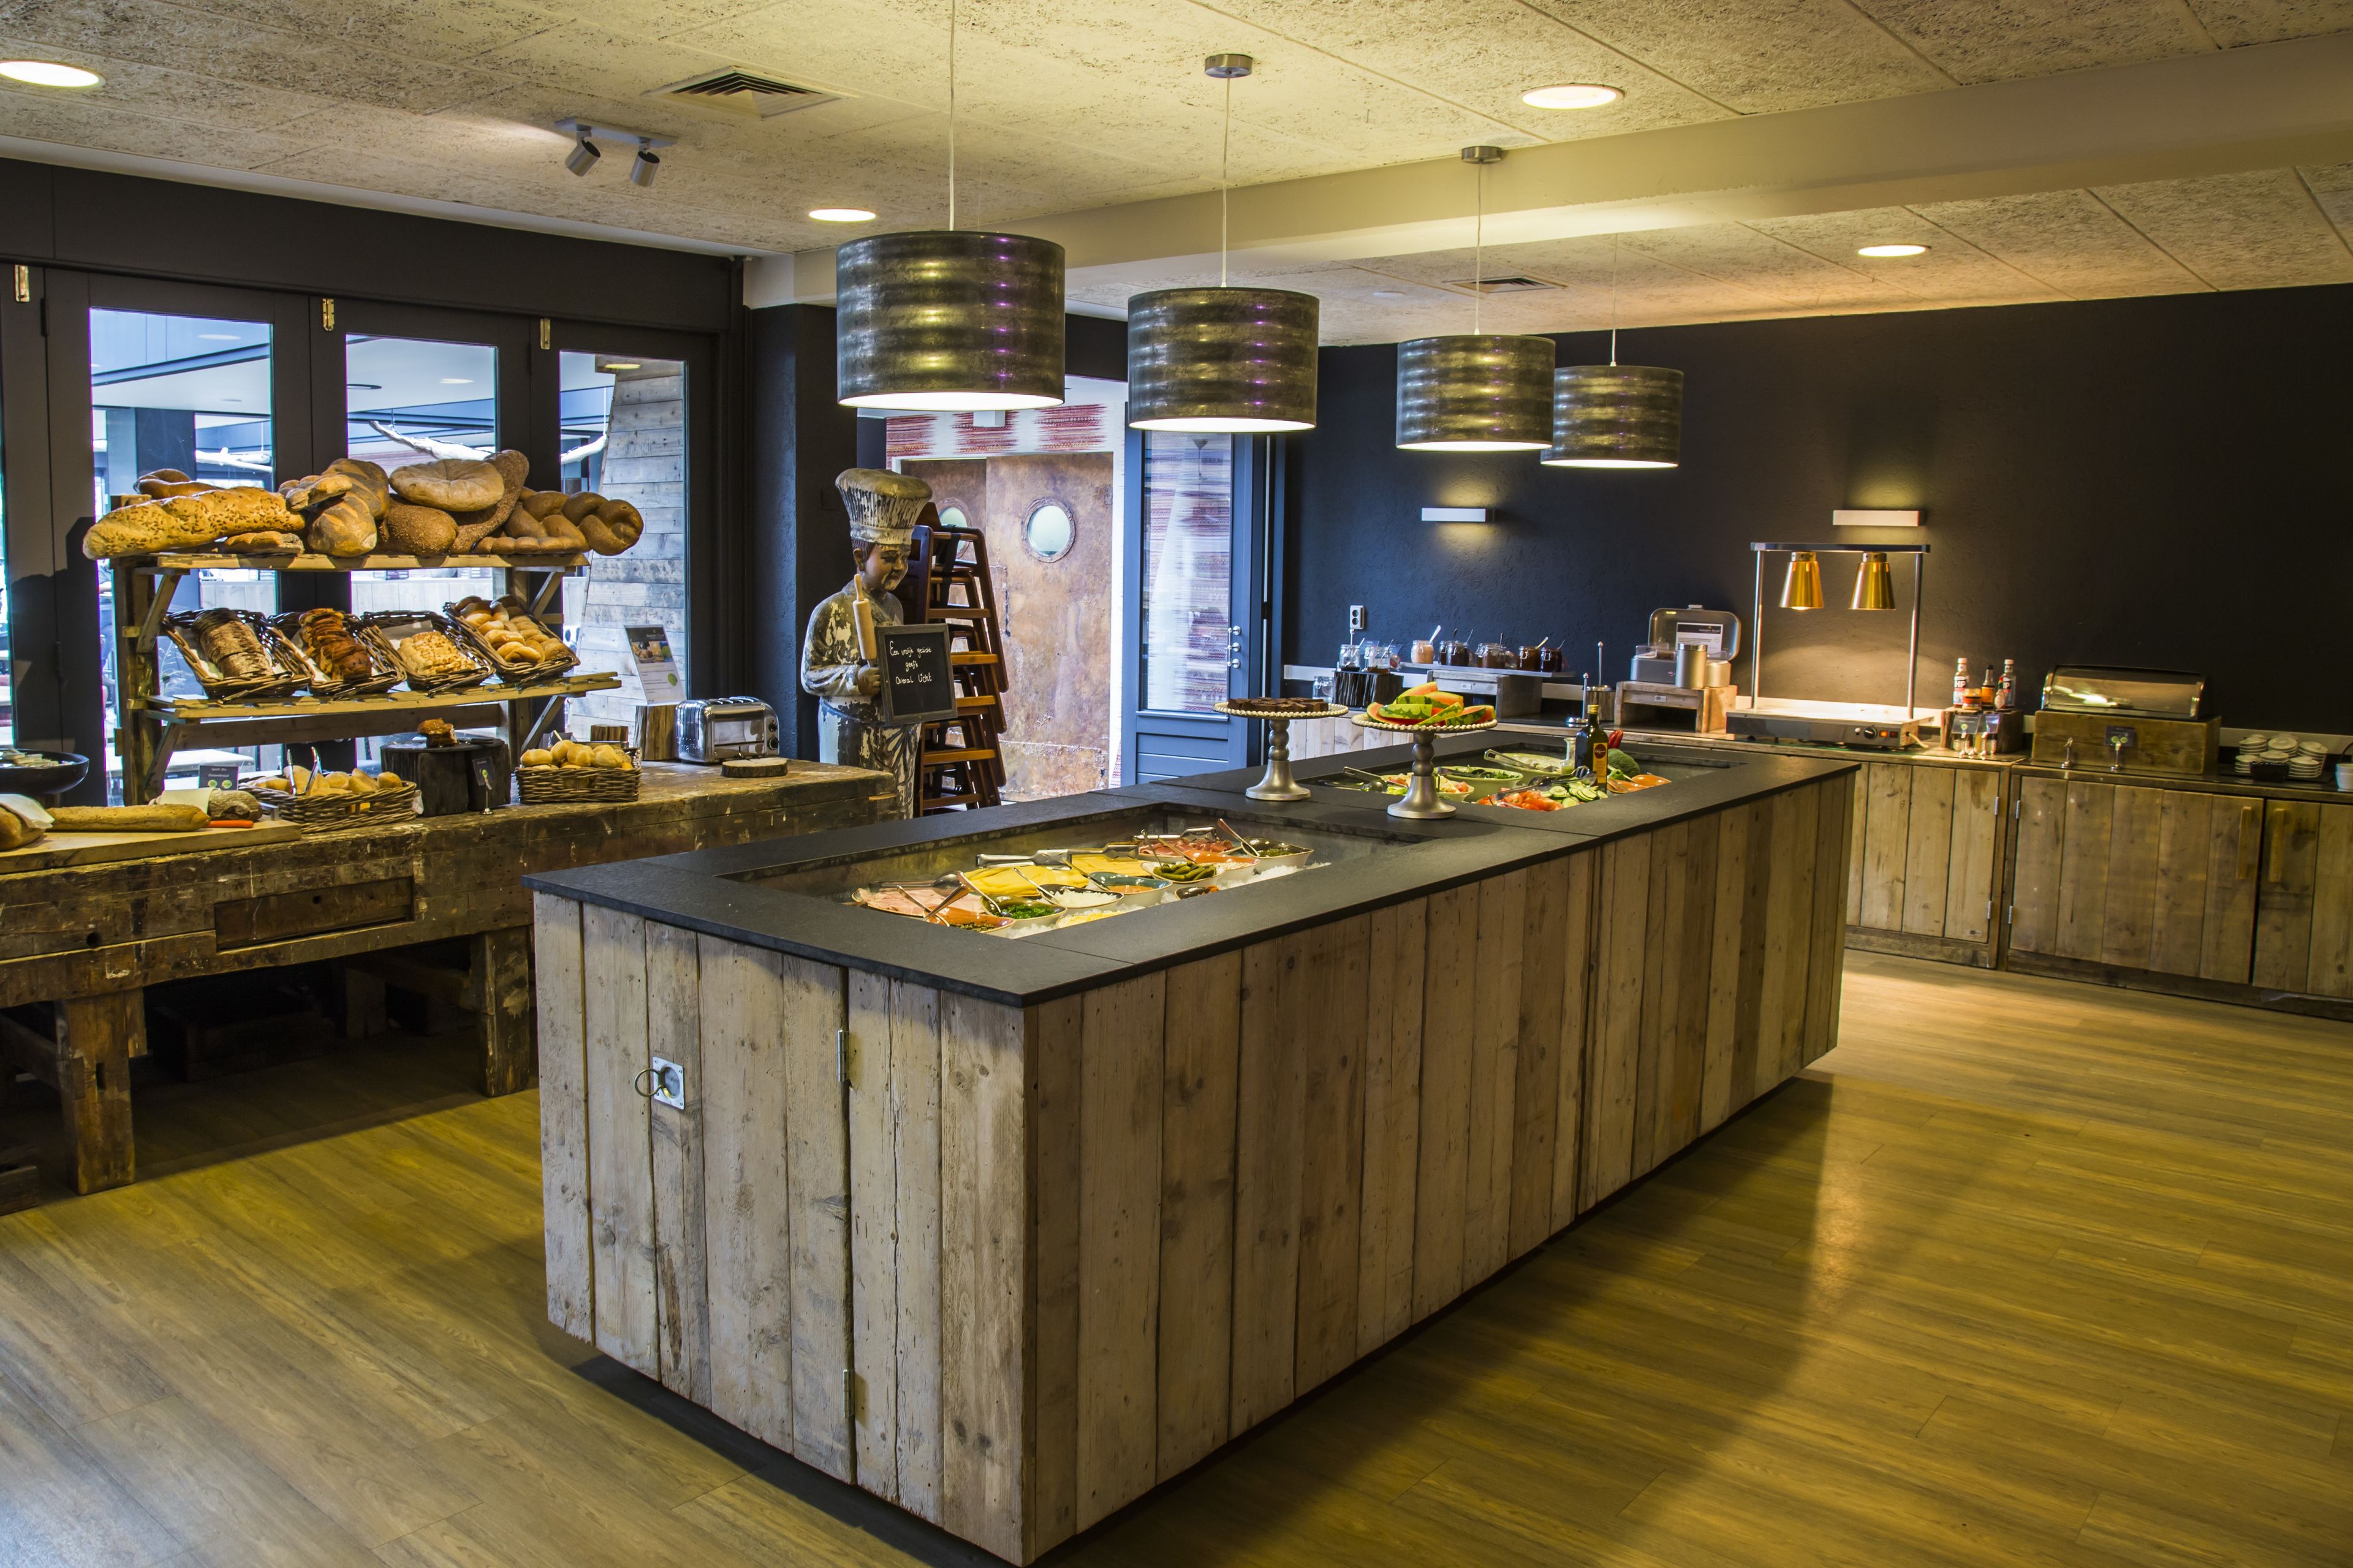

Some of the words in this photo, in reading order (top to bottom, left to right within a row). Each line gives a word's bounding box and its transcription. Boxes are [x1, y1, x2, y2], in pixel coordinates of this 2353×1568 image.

[890, 640, 900, 656] Een
[917, 647, 932, 658] gezicht
[905, 660, 919, 672] geeft
